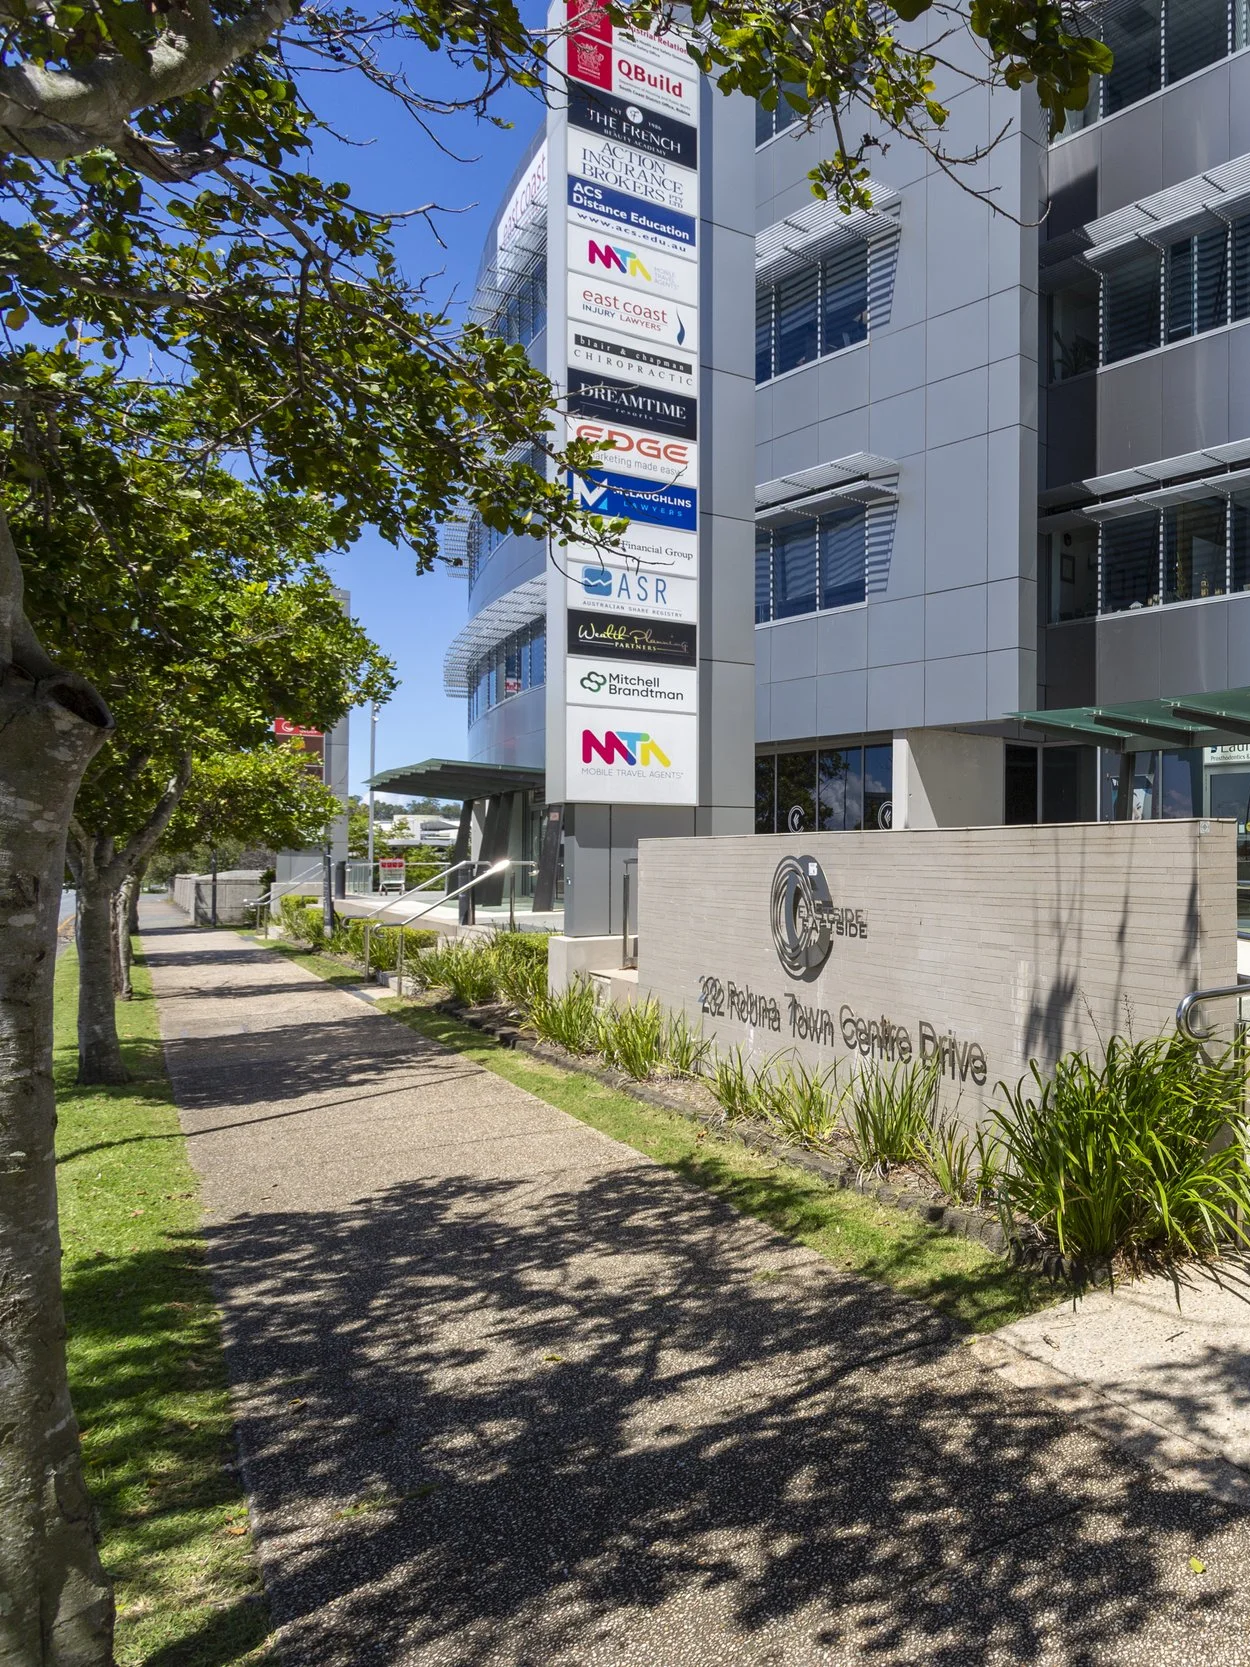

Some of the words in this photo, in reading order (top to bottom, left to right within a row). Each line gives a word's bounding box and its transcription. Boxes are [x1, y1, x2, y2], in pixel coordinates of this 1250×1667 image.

[658, 37, 688, 55] Relation
[617, 59, 682, 98] QBuild
[586, 107, 617, 130] THE
[623, 122, 681, 154] FRENCH
[604, 129, 632, 143] BEAUTY
[634, 140, 667, 157] ACADEMY
[582, 148, 684, 195] INSURANCE
[601, 142, 666, 175] ACTION
[573, 182, 603, 200] ACS
[582, 163, 666, 203] BROKERS
[572, 193, 628, 220] Distance
[630, 212, 690, 241] Education
[577, 211, 687, 253] www.acs.edu.au
[588, 239, 652, 282] MTA
[582, 289, 620, 311] east
[623, 300, 668, 324] coast
[582, 303, 616, 319] INJURY
[619, 314, 662, 332] LAWYERS
[574, 349, 694, 386] CHIROPRACTIC
[580, 335, 611, 352] blair
[619, 347, 627, 356] &
[635, 352, 685, 372] chapman
[579, 382, 687, 420] DREAMTIME
[615, 407, 654, 421] resorts
[576, 424, 689, 466] EDGE
[593, 452, 632, 469] arketing
[634, 460, 658, 473] made
[660, 466, 680, 478] easy
[623, 501, 683, 517] LAWYERS
[621, 540, 663, 555] Financial
[665, 547, 694, 561] Group
[617, 572, 668, 605] ASR
[582, 600, 625, 611] AUSTRALIAN
[628, 606, 649, 614] SHARE
[652, 609, 683, 618] REGISTRY
[578, 622, 628, 641] Wealth
[614, 641, 658, 652] PARTNERS
[608, 672, 660, 688] Mitchell
[608, 684, 684, 701] Brandtman
[582, 729, 671, 768] MTA
[581, 767, 613, 777] MOBILE
[616, 768, 647, 778] TRAVEL
[649, 770, 682, 780] AGENTS
[728, 981, 778, 1026] Robina
[784, 993, 832, 1041] Town
[839, 1004, 911, 1058] Centre
[919, 1021, 986, 1079] Drive
